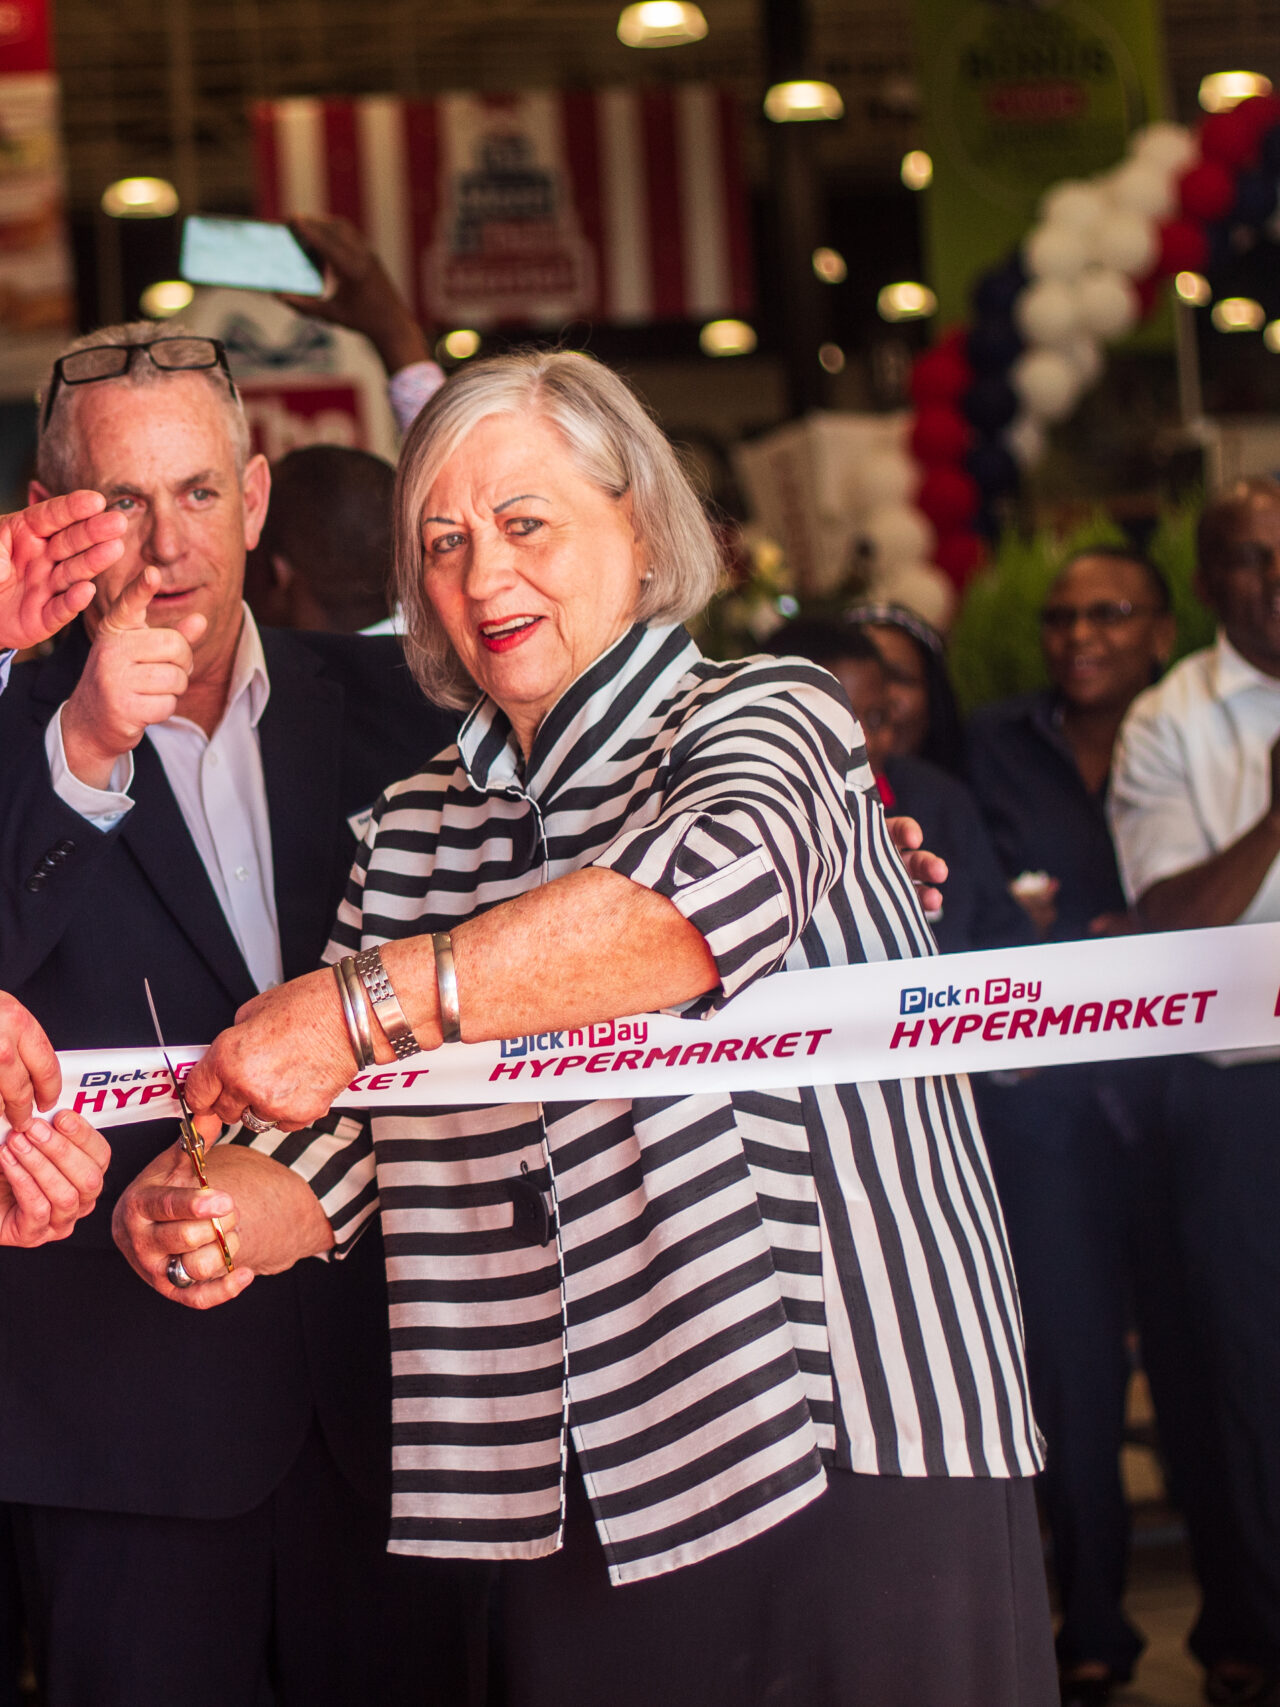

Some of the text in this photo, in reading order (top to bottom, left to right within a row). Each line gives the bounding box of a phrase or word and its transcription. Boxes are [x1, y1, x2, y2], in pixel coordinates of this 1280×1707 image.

[899, 977, 1042, 1015] Pick n Pay
[501, 1019, 648, 1058] Pick n Pay
[889, 990, 1218, 1049] HYPERMARKET
[488, 1028, 833, 1082] HYPERMARKET
[80, 1069, 149, 1088] Pick
[151, 1070, 170, 1079] n
